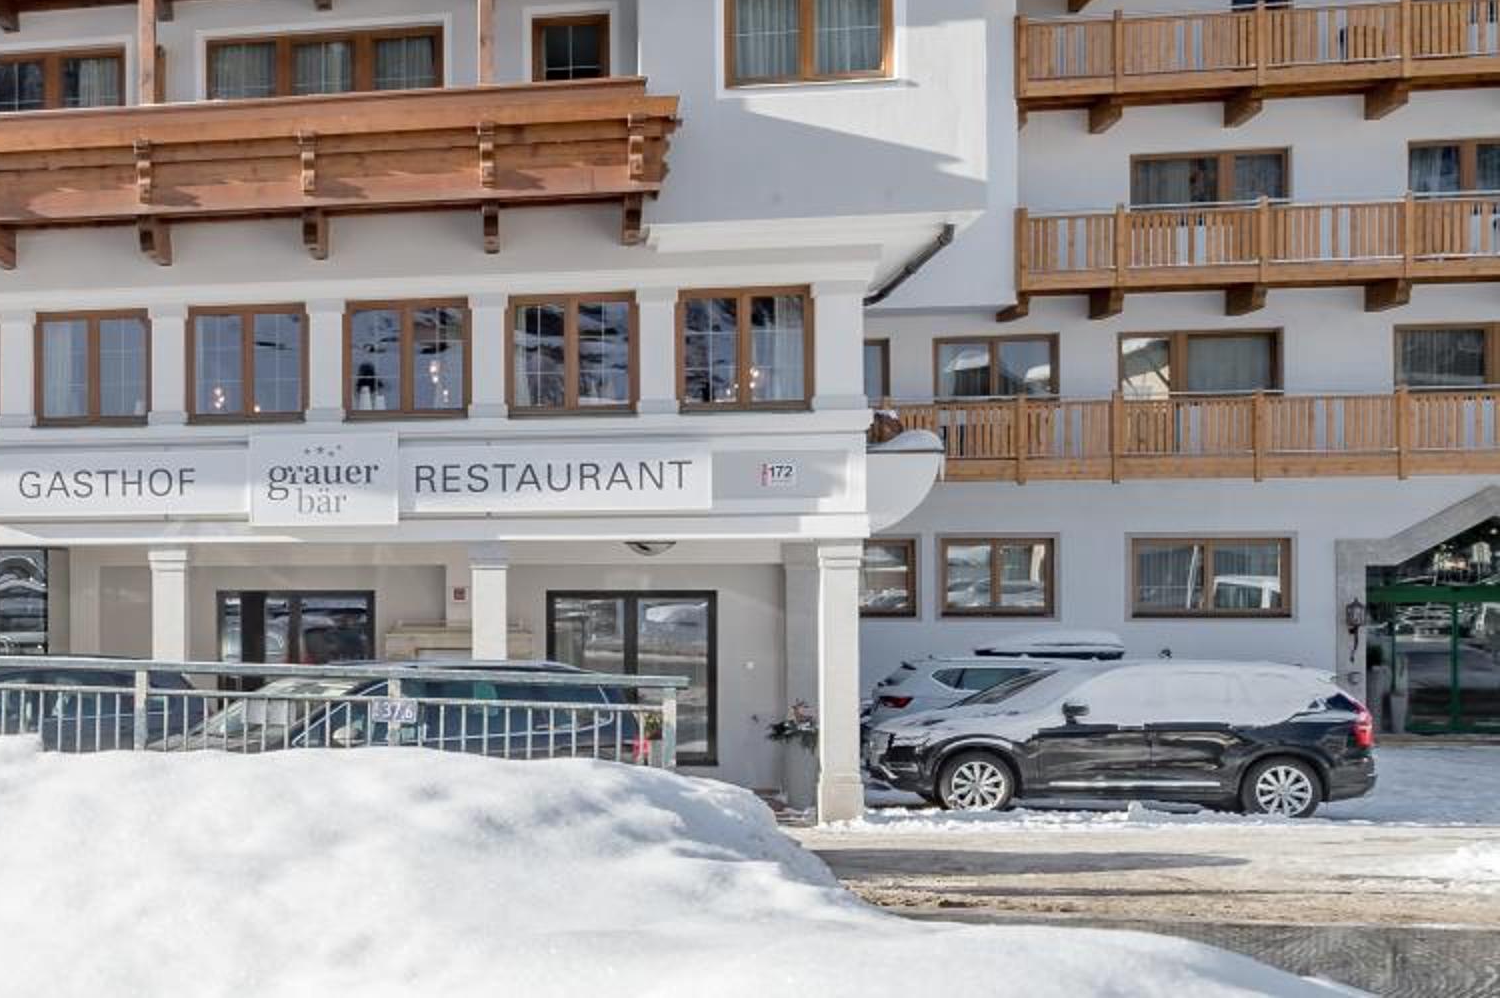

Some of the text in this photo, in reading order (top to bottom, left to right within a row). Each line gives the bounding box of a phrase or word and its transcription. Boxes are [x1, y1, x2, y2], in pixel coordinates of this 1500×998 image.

[19, 467, 196, 499] GASTHOF
[267, 463, 379, 501] grauer
[414, 460, 693, 493] RESTAURANT
[769, 464, 793, 478] 172
[296, 487, 348, 514] bär
